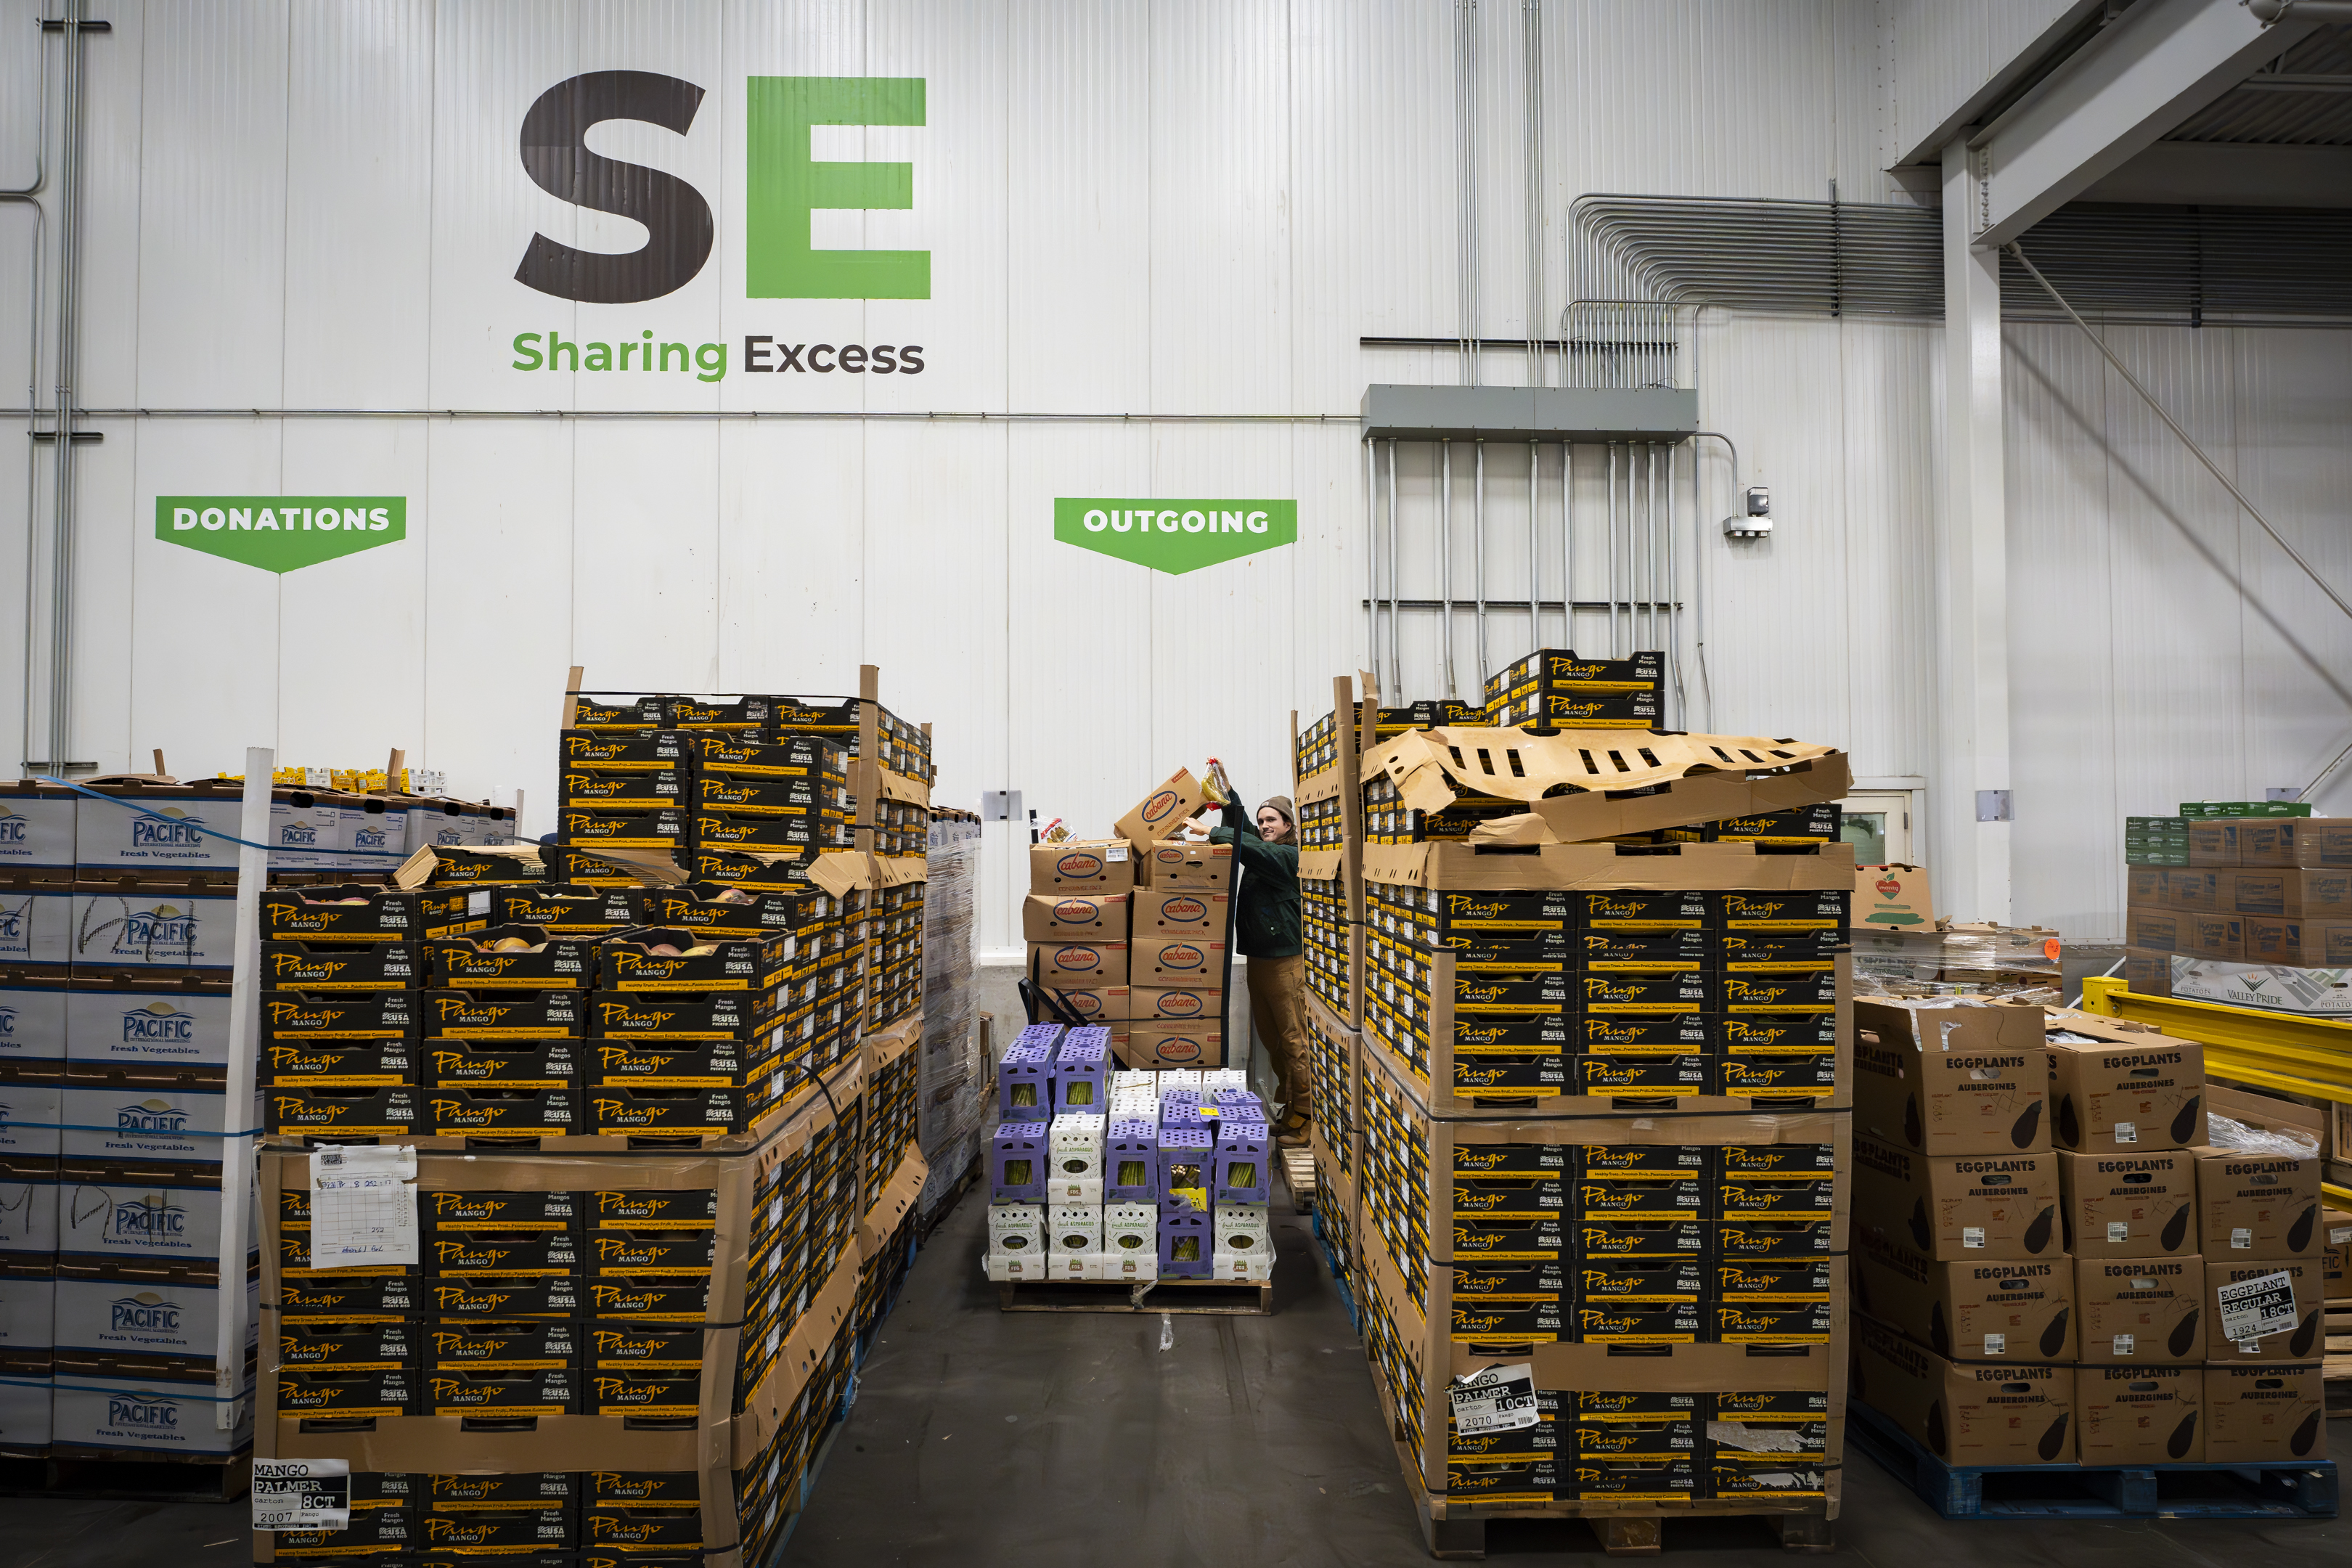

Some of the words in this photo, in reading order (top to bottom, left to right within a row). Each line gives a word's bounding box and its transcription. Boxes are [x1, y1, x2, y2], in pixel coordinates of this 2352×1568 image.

[514, 70, 931, 304] SE
[512, 330, 727, 383] Sharing
[745, 335, 925, 375] Excess
[173, 507, 390, 531] DONATIONS
[1083, 510, 1268, 534] OUTGOING
[1549, 657, 1606, 679] Pango
[576, 706, 620, 722] Pango
[1547, 695, 1604, 717] Pango
[566, 737, 628, 759] Pango
[700, 779, 760, 803] Pango
[1146, 793, 1172, 820] cabana
[133, 822, 203, 847] PACIFIC
[1061, 851, 1096, 870] cabana
[1057, 897, 1093, 915] cabana
[1166, 896, 1200, 913] cabana
[267, 903, 343, 931] Pango
[1058, 945, 1095, 962] cabana
[1163, 942, 1198, 960] cabana
[442, 949, 517, 976] Pango
[612, 952, 688, 979] Pango
[1161, 989, 1196, 1008] cabana
[1583, 979, 1647, 1001] Pango
[2180, 987, 2210, 995] POTATOES
[2227, 989, 2256, 1002] VALLEY
[2257, 995, 2282, 1005] PRIDE
[123, 1016, 192, 1042] PACIFIC
[1160, 1035, 1195, 1053] cabana
[1946, 1056, 2025, 1069] EGGPLANTS
[2104, 1053, 2181, 1068] EGGPLANTS
[1958, 1082, 2017, 1092] AUBERGINES
[2116, 1080, 2175, 1090] AUBERGINES
[1956, 1161, 2035, 1173] EGGPLANTS
[2098, 1159, 2173, 1172] EGGPLANTS
[2225, 1161, 2300, 1175] EGGPLANTS
[1581, 1186, 1644, 1209] Pango
[1969, 1188, 2028, 1196] AUBERGINES
[2110, 1185, 2166, 1195] AUBERGINES
[2237, 1188, 2292, 1197] AUBERGINES
[434, 1241, 510, 1267] Pango
[1975, 1265, 2051, 1279] EGGPLANTS
[2104, 1265, 2182, 1277] EGGPLANTS
[1986, 1292, 2044, 1302] AUBERGINES
[2117, 1291, 2174, 1299] AUBERGINES
[2221, 1277, 2285, 1300] EGGPLANT
[2223, 1292, 2282, 1314] REGULAR
[2261, 1303, 2292, 1320] 18CT
[111, 1307, 180, 1331] PACIFIC
[1718, 1308, 1780, 1333] Pango
[2233, 1324, 2256, 1336] 1924
[130, 1336, 187, 1344] Vegetables
[593, 1331, 668, 1357] Pango
[1975, 1368, 2051, 1381] EGGPLANTS
[430, 1378, 505, 1404] Pango
[1455, 1386, 1511, 1403] PALMER
[1497, 1395, 1533, 1412] 10CT
[1987, 1395, 2045, 1405] AUBERGINES
[108, 1401, 177, 1427] PACIFIC
[1466, 1416, 1492, 1426] 2070
[127, 1432, 185, 1440] Vegetables
[255, 1465, 309, 1476] MANGO
[256, 1481, 322, 1493] PALMER
[303, 1495, 335, 1508] 8CT
[261, 1513, 292, 1522] 2007
